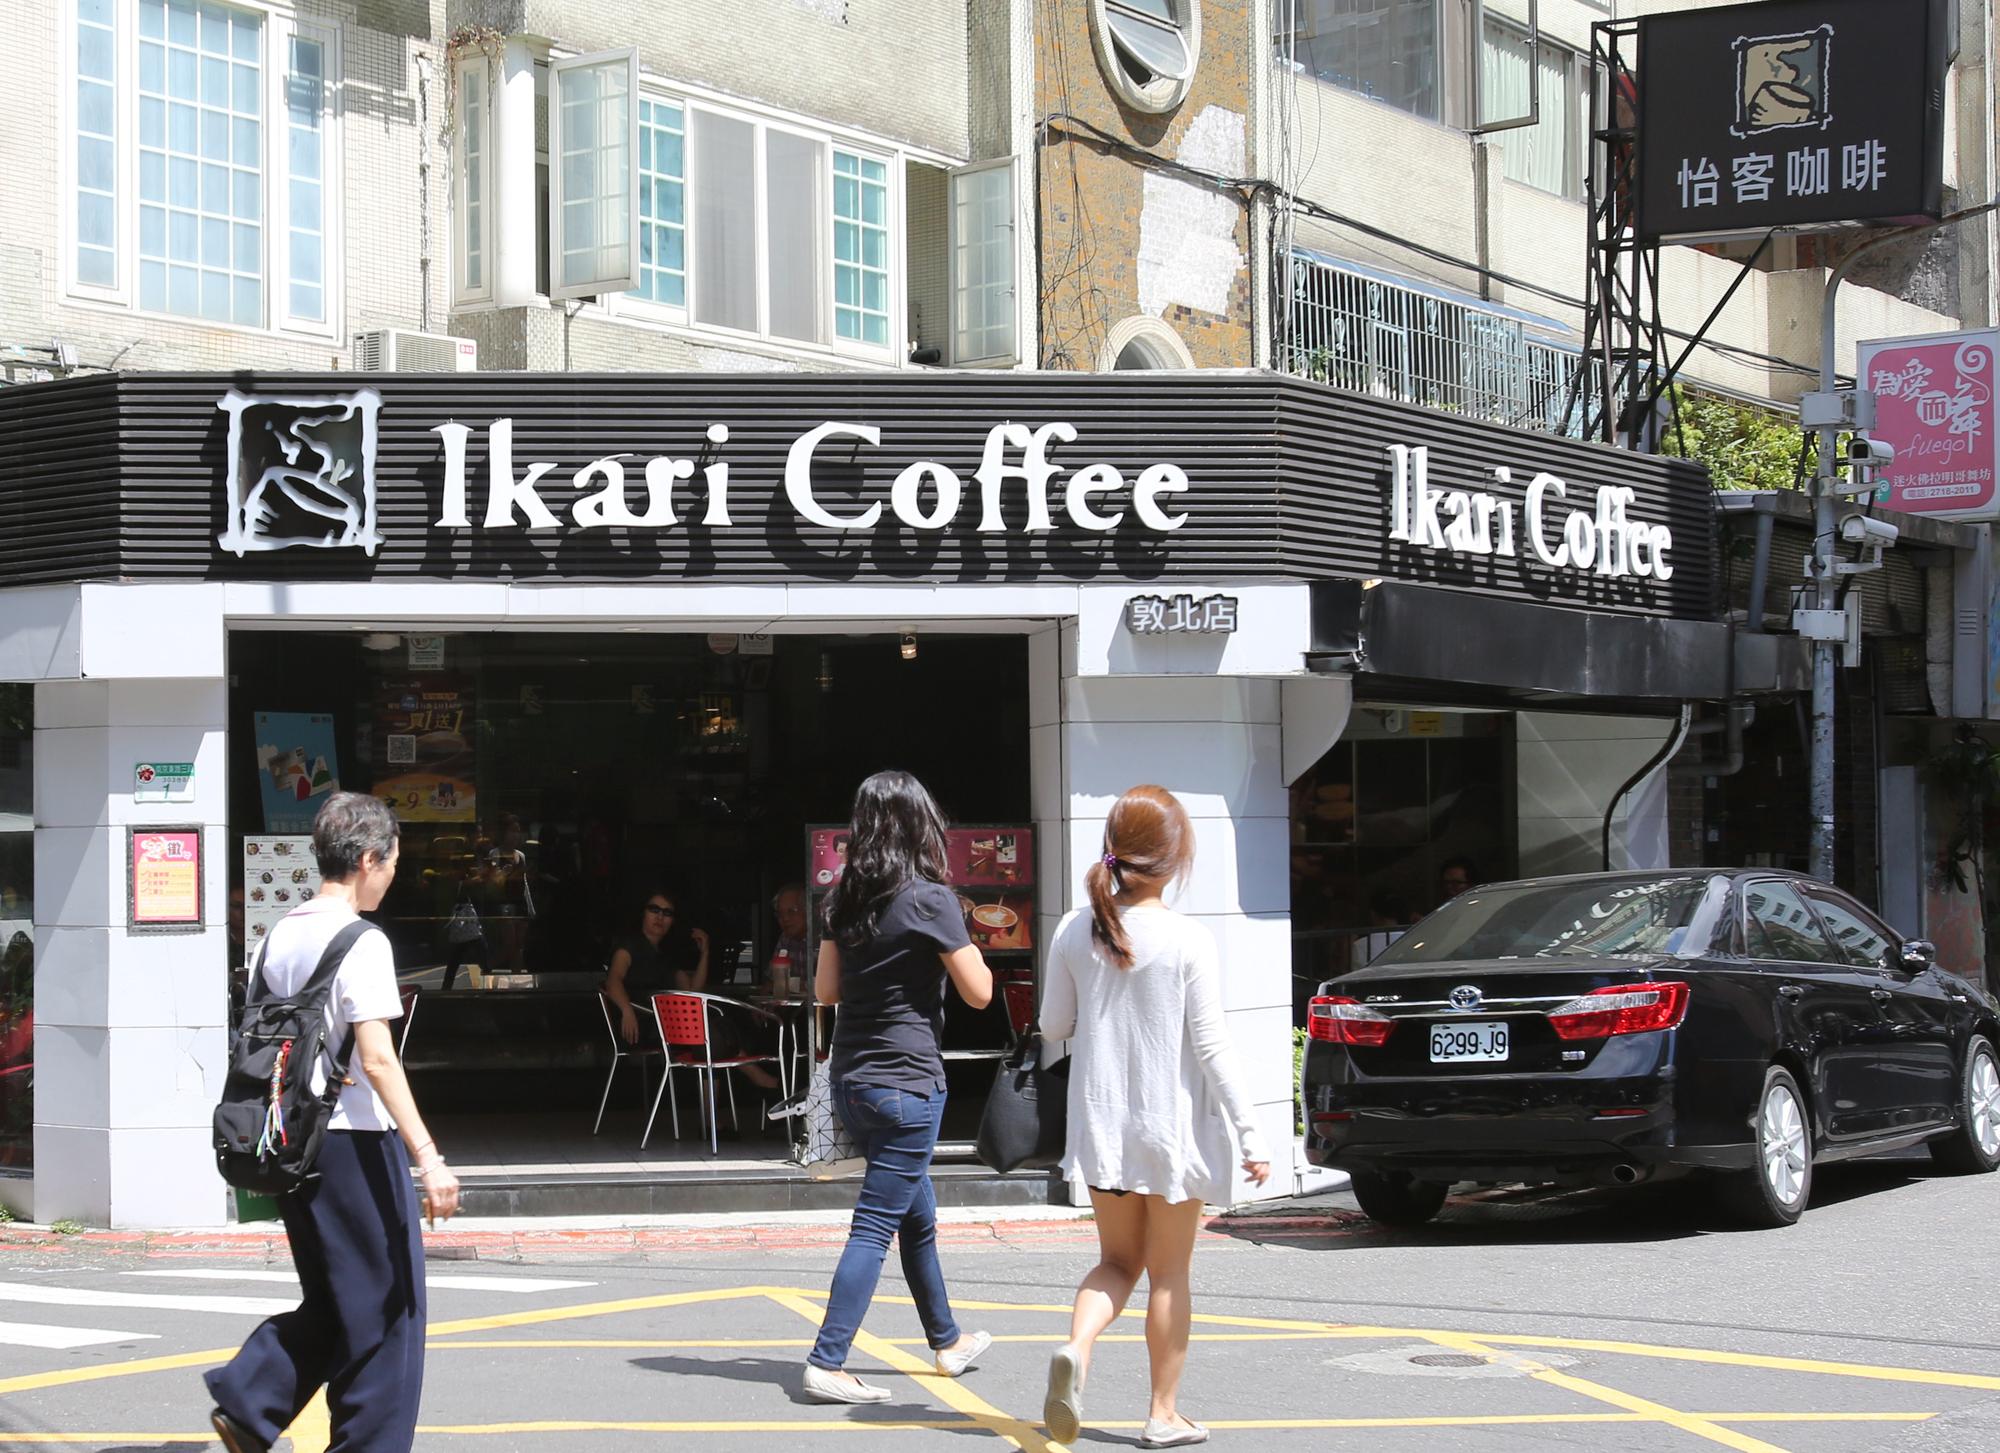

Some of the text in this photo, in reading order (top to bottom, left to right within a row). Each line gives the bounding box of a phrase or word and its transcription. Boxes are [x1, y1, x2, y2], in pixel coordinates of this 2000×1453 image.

[1677, 139, 1888, 208] 怡客咖啡
[430, 417, 1190, 532] Ikari Coffee
[1897, 433, 1966, 465] fuego
[1386, 443, 1674, 580] Ikari Coffee
[1131, 596, 1238, 633] 敦北店
